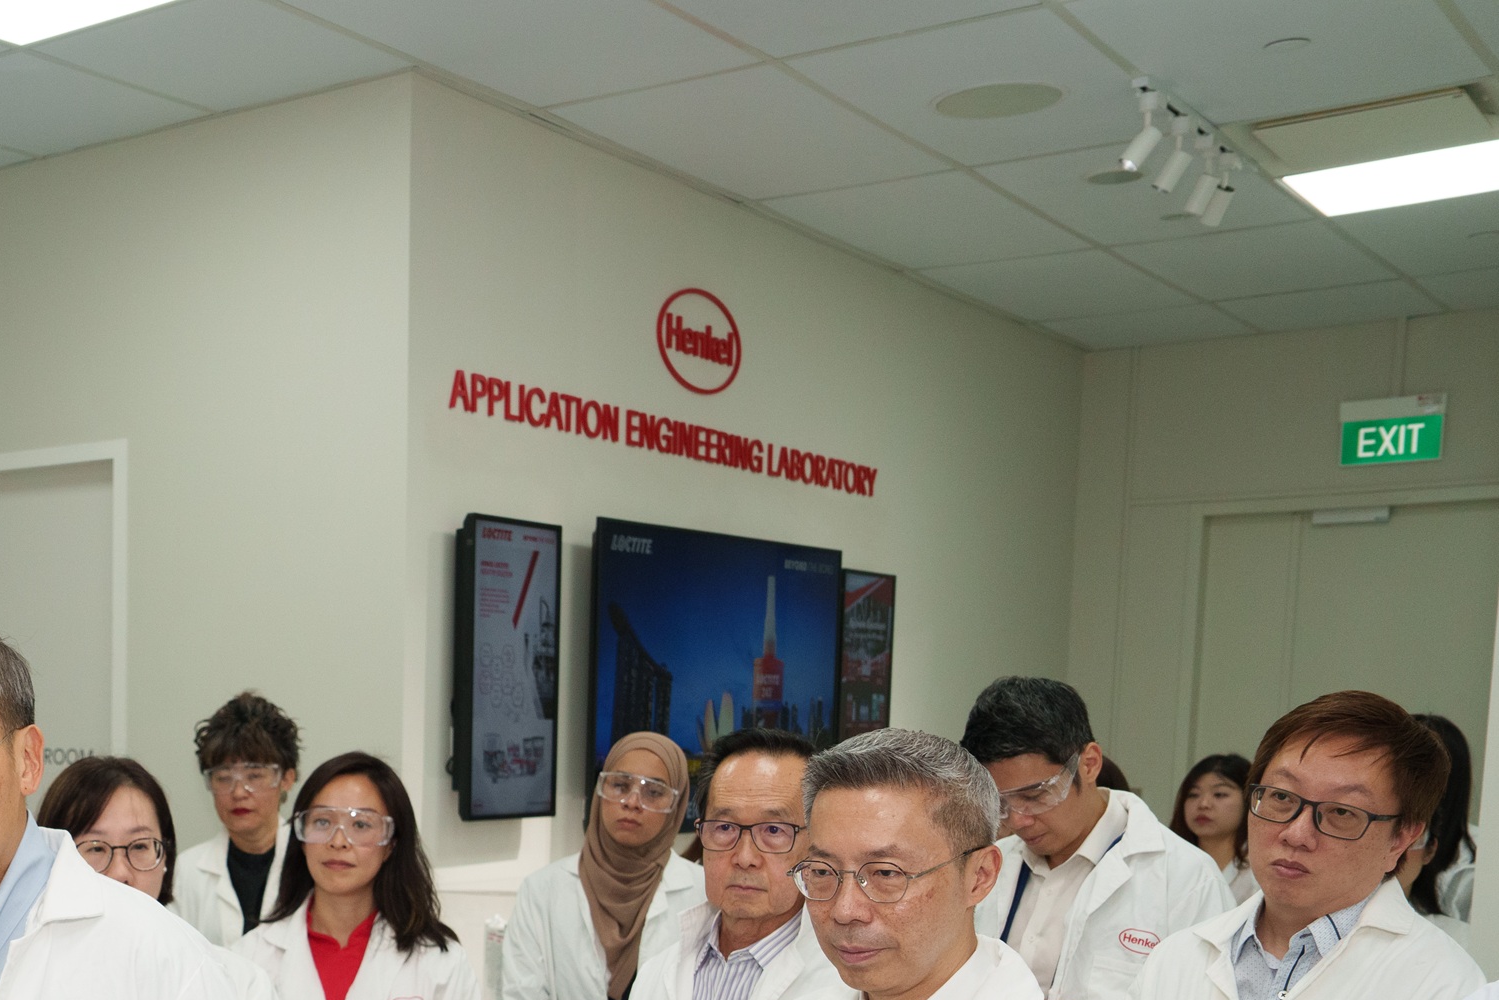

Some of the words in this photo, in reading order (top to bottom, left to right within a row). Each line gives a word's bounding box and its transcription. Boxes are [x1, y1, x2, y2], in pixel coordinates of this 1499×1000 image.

[664, 312, 735, 367] Henkel
[449, 369, 619, 443] APPLICATION
[625, 409, 764, 474] ENGINEERING
[767, 443, 878, 497] LABORATORY
[1356, 422, 1426, 459] EXIT
[611, 534, 653, 555] LOCTITE
